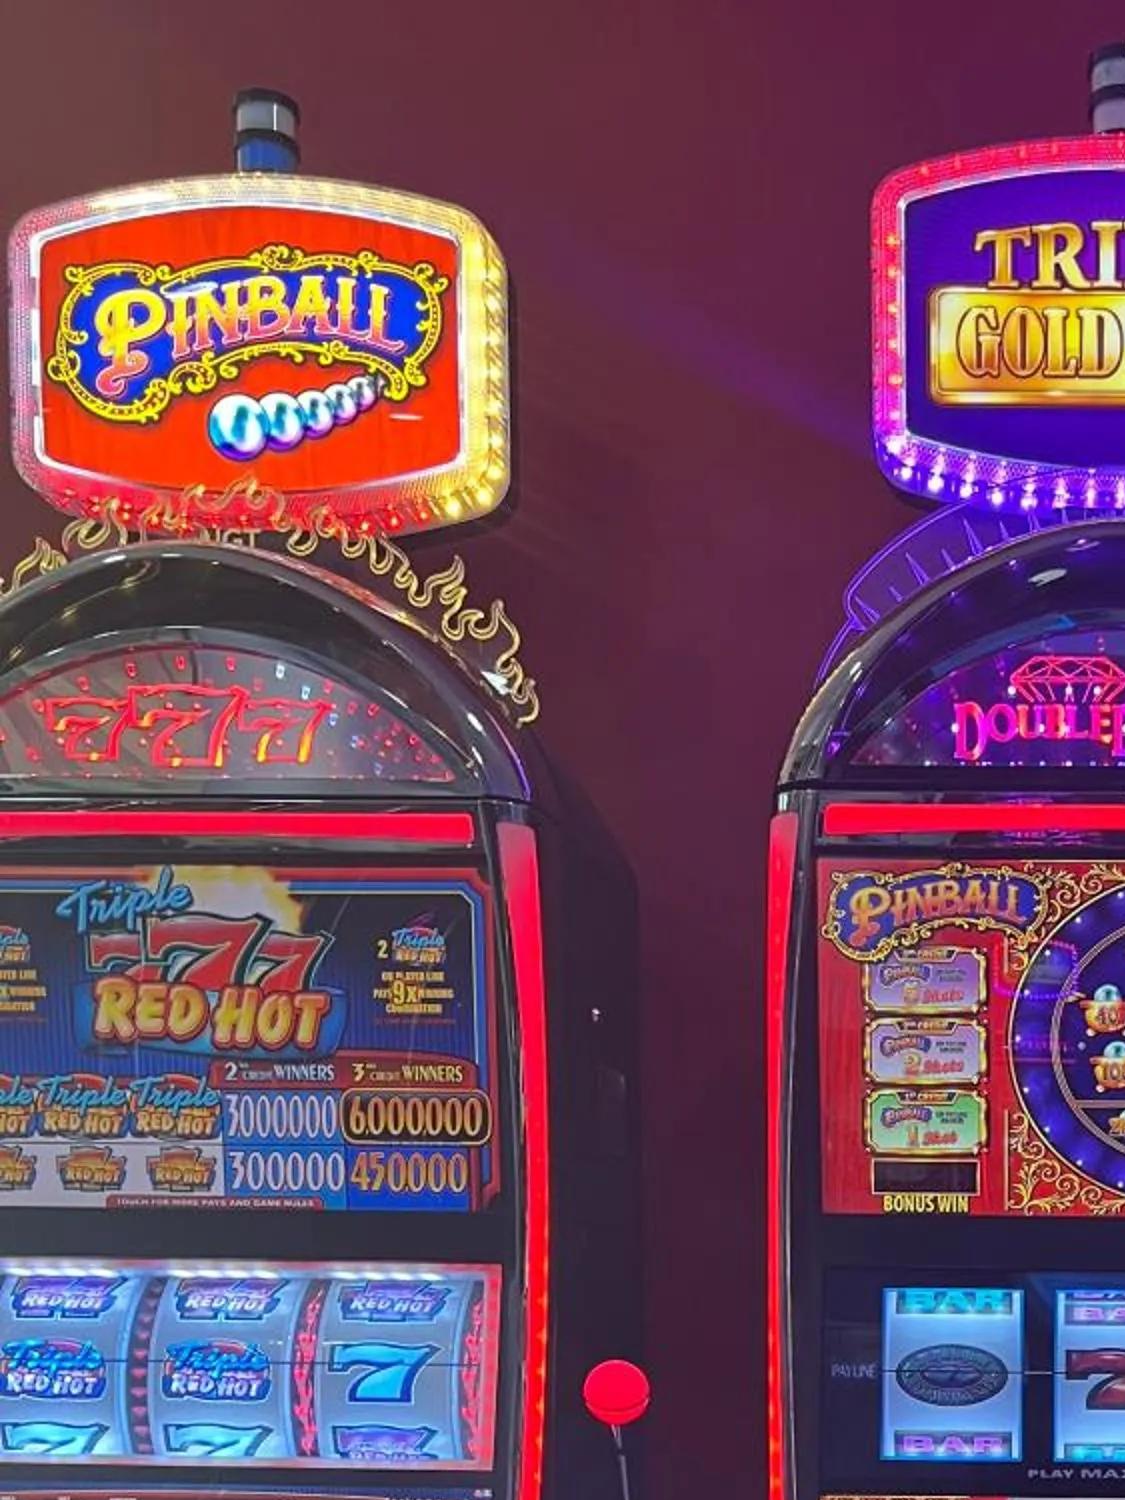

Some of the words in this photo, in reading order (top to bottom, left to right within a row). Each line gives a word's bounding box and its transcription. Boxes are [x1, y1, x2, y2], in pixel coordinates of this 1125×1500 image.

[94, 275, 405, 396] PINBALL
[957, 305, 1124, 379] GOLD
[954, 702, 1113, 760] DOUBLE
[56, 865, 194, 934] Triple
[849, 879, 1028, 946] PINBALL
[377, 939, 389, 959] 2
[94, 976, 208, 1044] RED
[212, 984, 332, 1050] HOT
[272, 1063, 335, 1082] WINNERS
[400, 1065, 464, 1083] WINNERS
[129, 1076, 220, 1114] Triple
[135, 1110, 175, 1134] RED
[176, 1111, 216, 1137] HOT
[883, 1194, 934, 1213] BONUS
[937, 1194, 969, 1214] WIN
[905, 1290, 1004, 1311] BAR
[327, 1342, 441, 1403] 7
[902, 1435, 1004, 1454] BAR
[1027, 1468, 1074, 1480] PLAY
